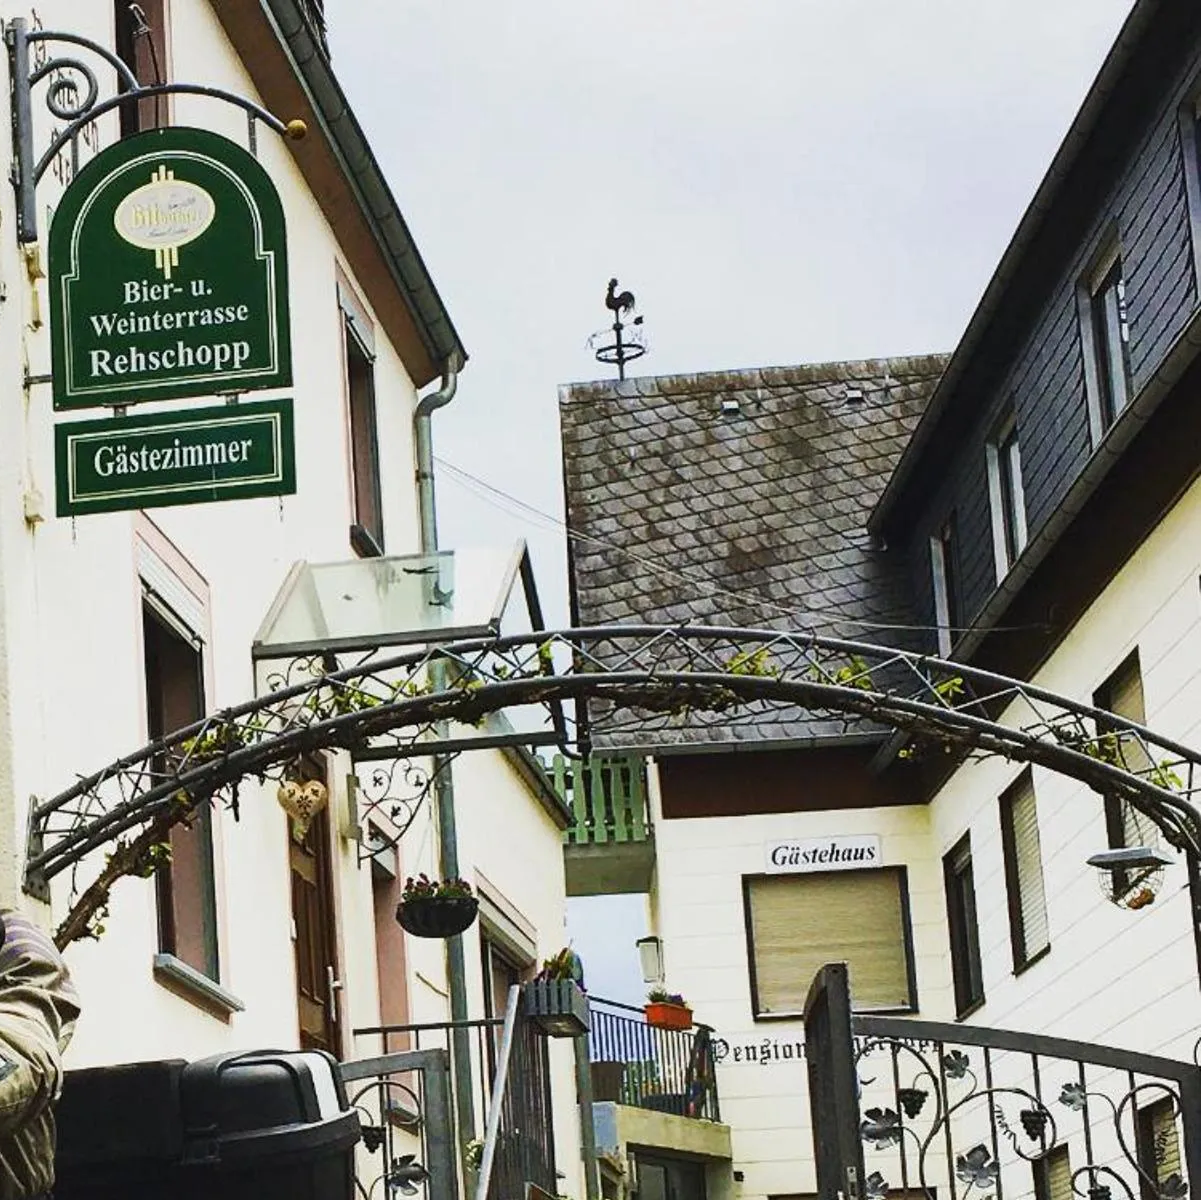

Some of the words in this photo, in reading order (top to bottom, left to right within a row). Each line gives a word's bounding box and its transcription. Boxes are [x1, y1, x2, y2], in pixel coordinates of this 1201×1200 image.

[123, 280, 183, 304] Bier-
[191, 279, 213, 297] u.
[90, 303, 249, 337] Weinterrasse
[89, 340, 250, 377] Rehschopp
[94, 438, 253, 477] Gästezimmer
[771, 843, 875, 866] Gästehaus
